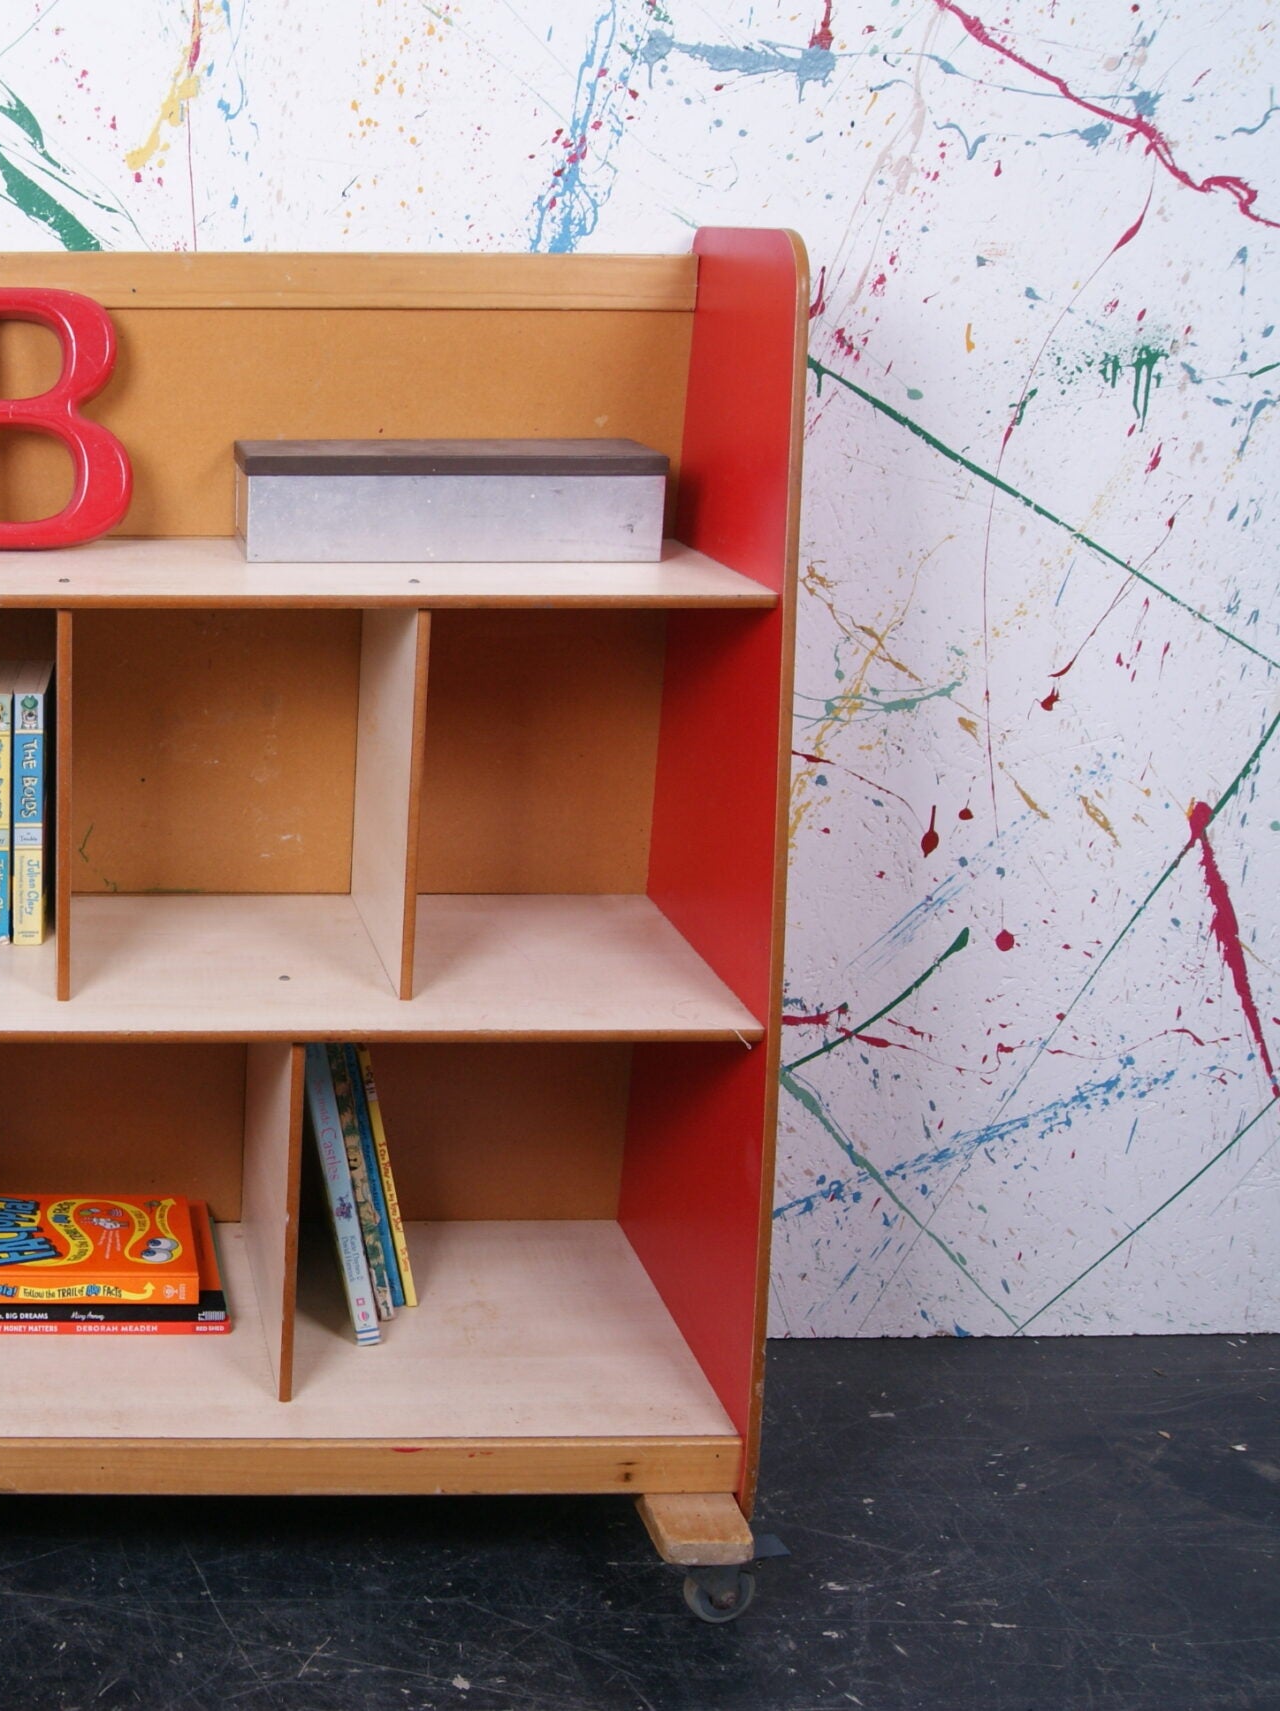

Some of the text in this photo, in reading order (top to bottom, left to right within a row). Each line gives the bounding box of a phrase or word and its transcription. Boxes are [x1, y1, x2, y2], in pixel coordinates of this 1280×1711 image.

[20, 738, 39, 819] THE BOLDS
[26, 858, 41, 889] Julian
[24, 890, 40, 917] Clary
[320, 1127, 342, 1181] Castles
[23, 1287, 45, 1298] Follow
[46, 1288, 56, 1298] the
[57, 1286, 78, 1298] TRAIL
[102, 1285, 122, 1298] FACTS
[5, 1312, 18, 1320] BIG
[19, 1312, 49, 1320] DREAMS
